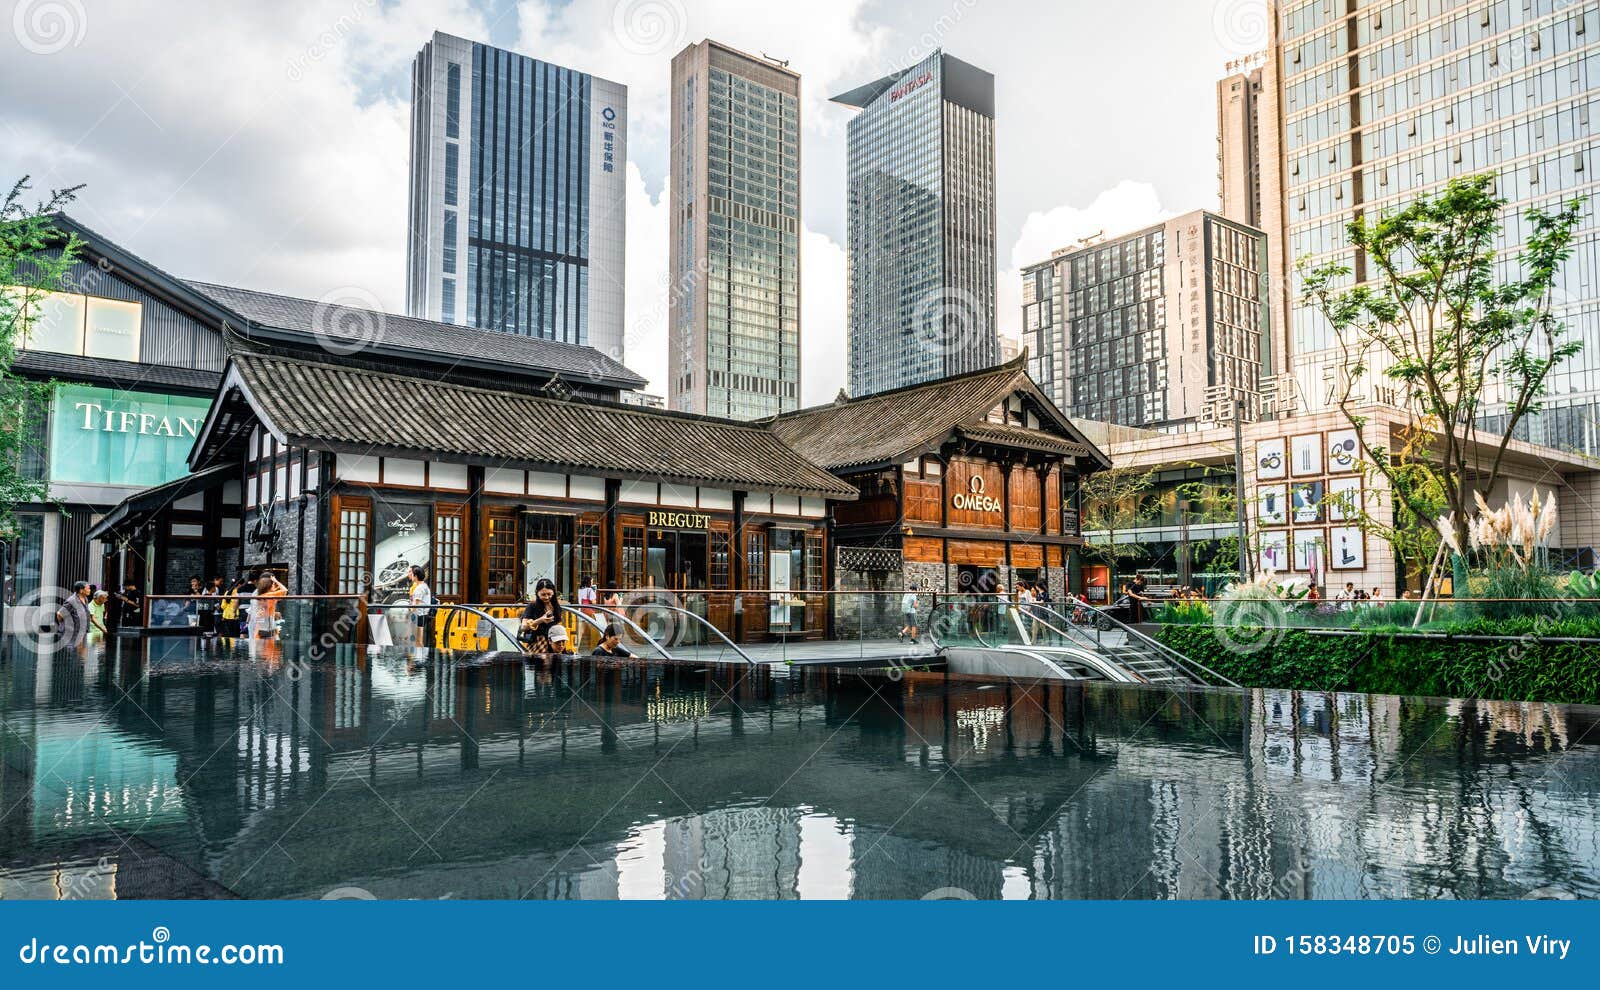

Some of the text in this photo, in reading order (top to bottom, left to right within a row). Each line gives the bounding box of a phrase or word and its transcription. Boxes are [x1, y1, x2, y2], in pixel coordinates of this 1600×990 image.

[890, 71, 932, 103] FANTASIA
[75, 402, 205, 438] TIFFAN
[953, 493, 1002, 512] OMEGA
[649, 511, 711, 529] BREGUET
